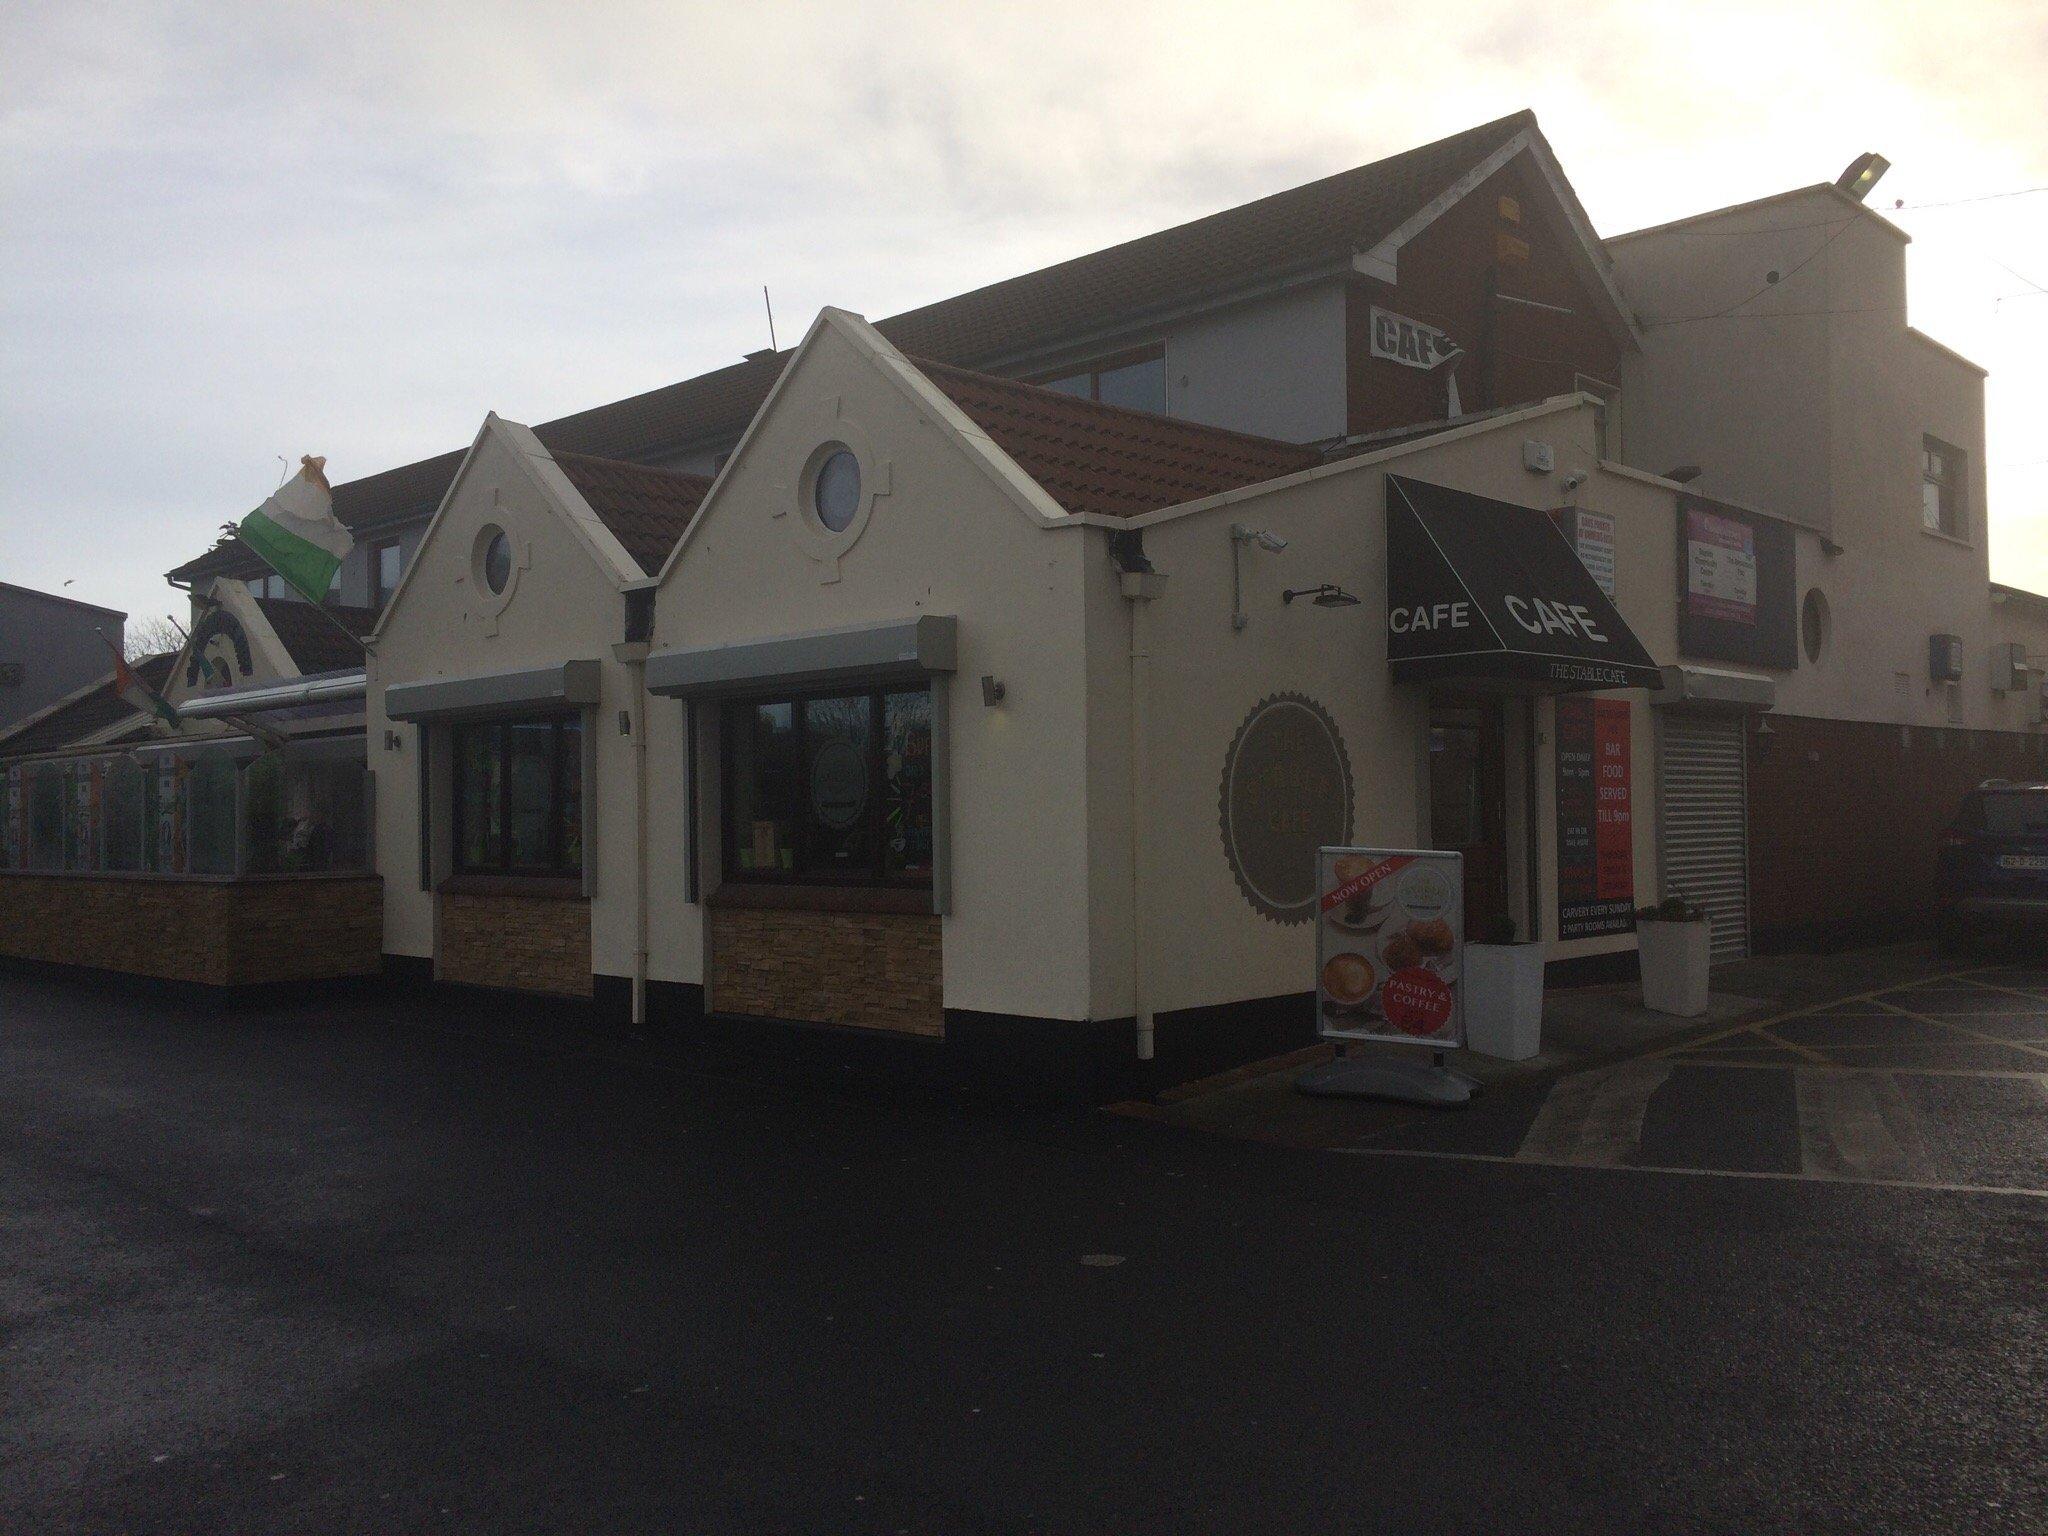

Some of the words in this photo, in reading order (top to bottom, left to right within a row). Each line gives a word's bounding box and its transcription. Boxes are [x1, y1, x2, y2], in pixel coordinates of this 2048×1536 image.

[1389, 602, 1470, 634] CAFE
[1504, 595, 1608, 643] CAFE
[1551, 663, 1568, 679] THE
[1570, 665, 1603, 682] STABLE
[1604, 668, 1628, 684] CAFE
[1560, 752, 1576, 762] OPEN
[1605, 743, 1621, 756] BAR
[1602, 765, 1624, 778] FOOD
[1600, 787, 1627, 800] SERVED
[1598, 810, 1612, 822] TILL
[1332, 882, 1359, 904] NOW
[1360, 863, 1392, 885] OPEN
[1562, 906, 1590, 919] CARVERY
[1590, 904, 1608, 916] EVERY
[1609, 902, 1632, 914] SUNDAY
[1567, 922, 1584, 934] PARTY
[1585, 920, 1605, 932] ROOMS
[1389, 979, 1436, 999] PASTRY
[1438, 991, 1448, 1002] &
[1393, 992, 1440, 1013] COFFEE
